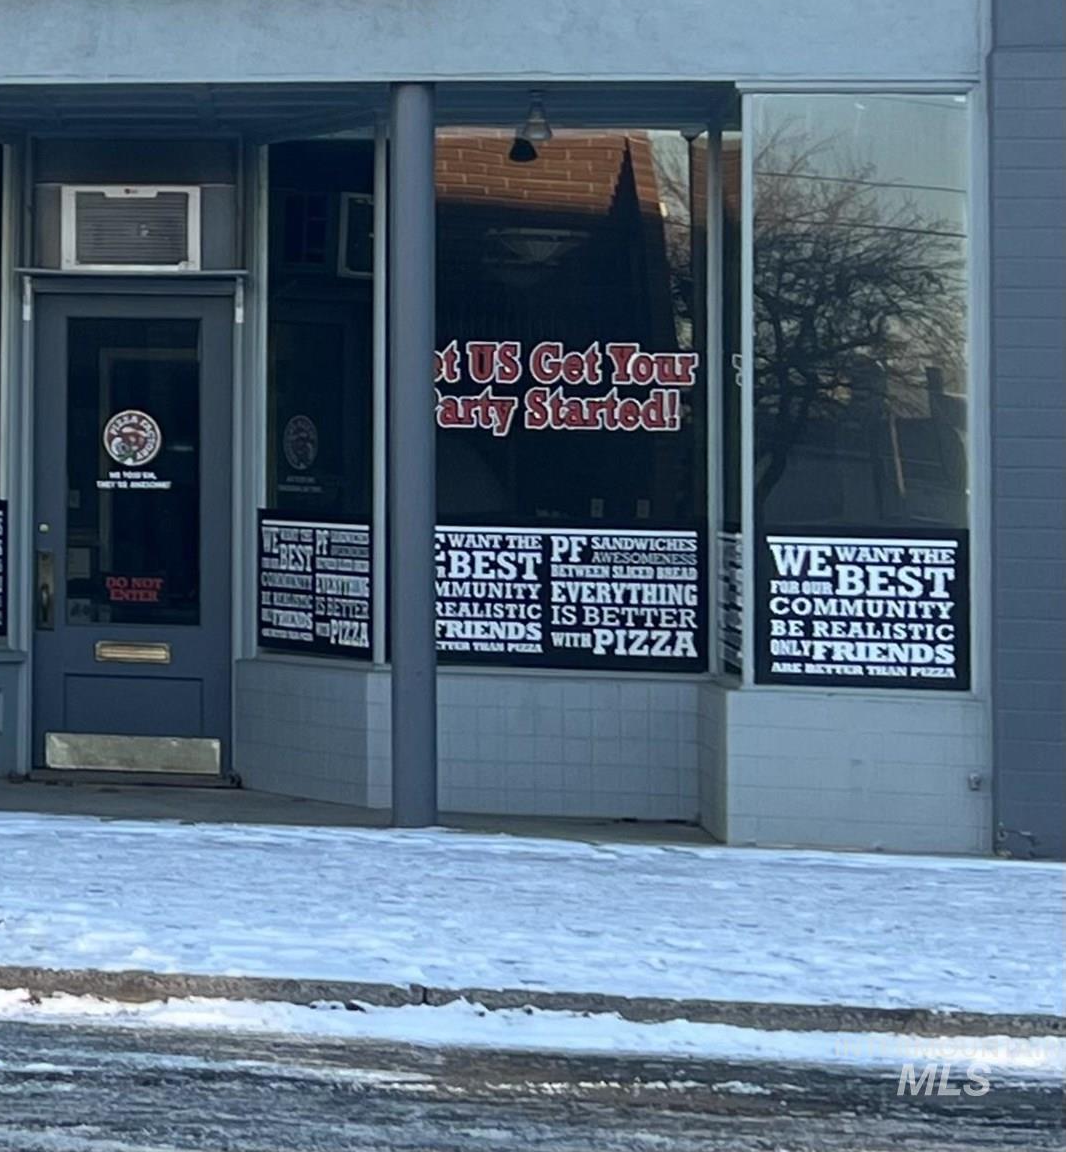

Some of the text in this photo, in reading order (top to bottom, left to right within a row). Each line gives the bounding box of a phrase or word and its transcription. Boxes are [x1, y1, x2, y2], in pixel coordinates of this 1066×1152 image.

[466, 341, 522, 384] US
[529, 340, 602, 384] Get
[606, 341, 699, 385] Your
[434, 385, 681, 437] arty Started!
[447, 533, 503, 549] WANT
[505, 534, 542, 550] THE
[550, 535, 697, 563] PF SANDWICHES
[280, 544, 313, 572] BEST
[448, 550, 542, 580] BEST
[591, 551, 697, 565] AWESOMENESS
[769, 545, 955, 577] WE WANT THE
[106, 576, 164, 590] DO NOT
[551, 564, 698, 581] BETWEEN SLICED BREAD
[770, 564, 955, 598] FOR OUR BEST
[110, 589, 159, 602] ENTER
[435, 580, 542, 600] MMUNITY
[550, 581, 698, 606] EVERYTHING
[551, 605, 698, 628] IS BETTER
[769, 598, 955, 619] COMMUNITY
[330, 619, 369, 648] PIZZA
[435, 619, 542, 641] FRIENDS
[770, 619, 955, 641] BE REALISTIC
[472, 642, 505, 652] THAN
[507, 642, 543, 653] PIZZA
[550, 628, 698, 658] WITH PIZZA
[770, 639, 956, 664] ONLY FRIENDS
[771, 662, 956, 678] ARE BETTER THAN PIZZA
